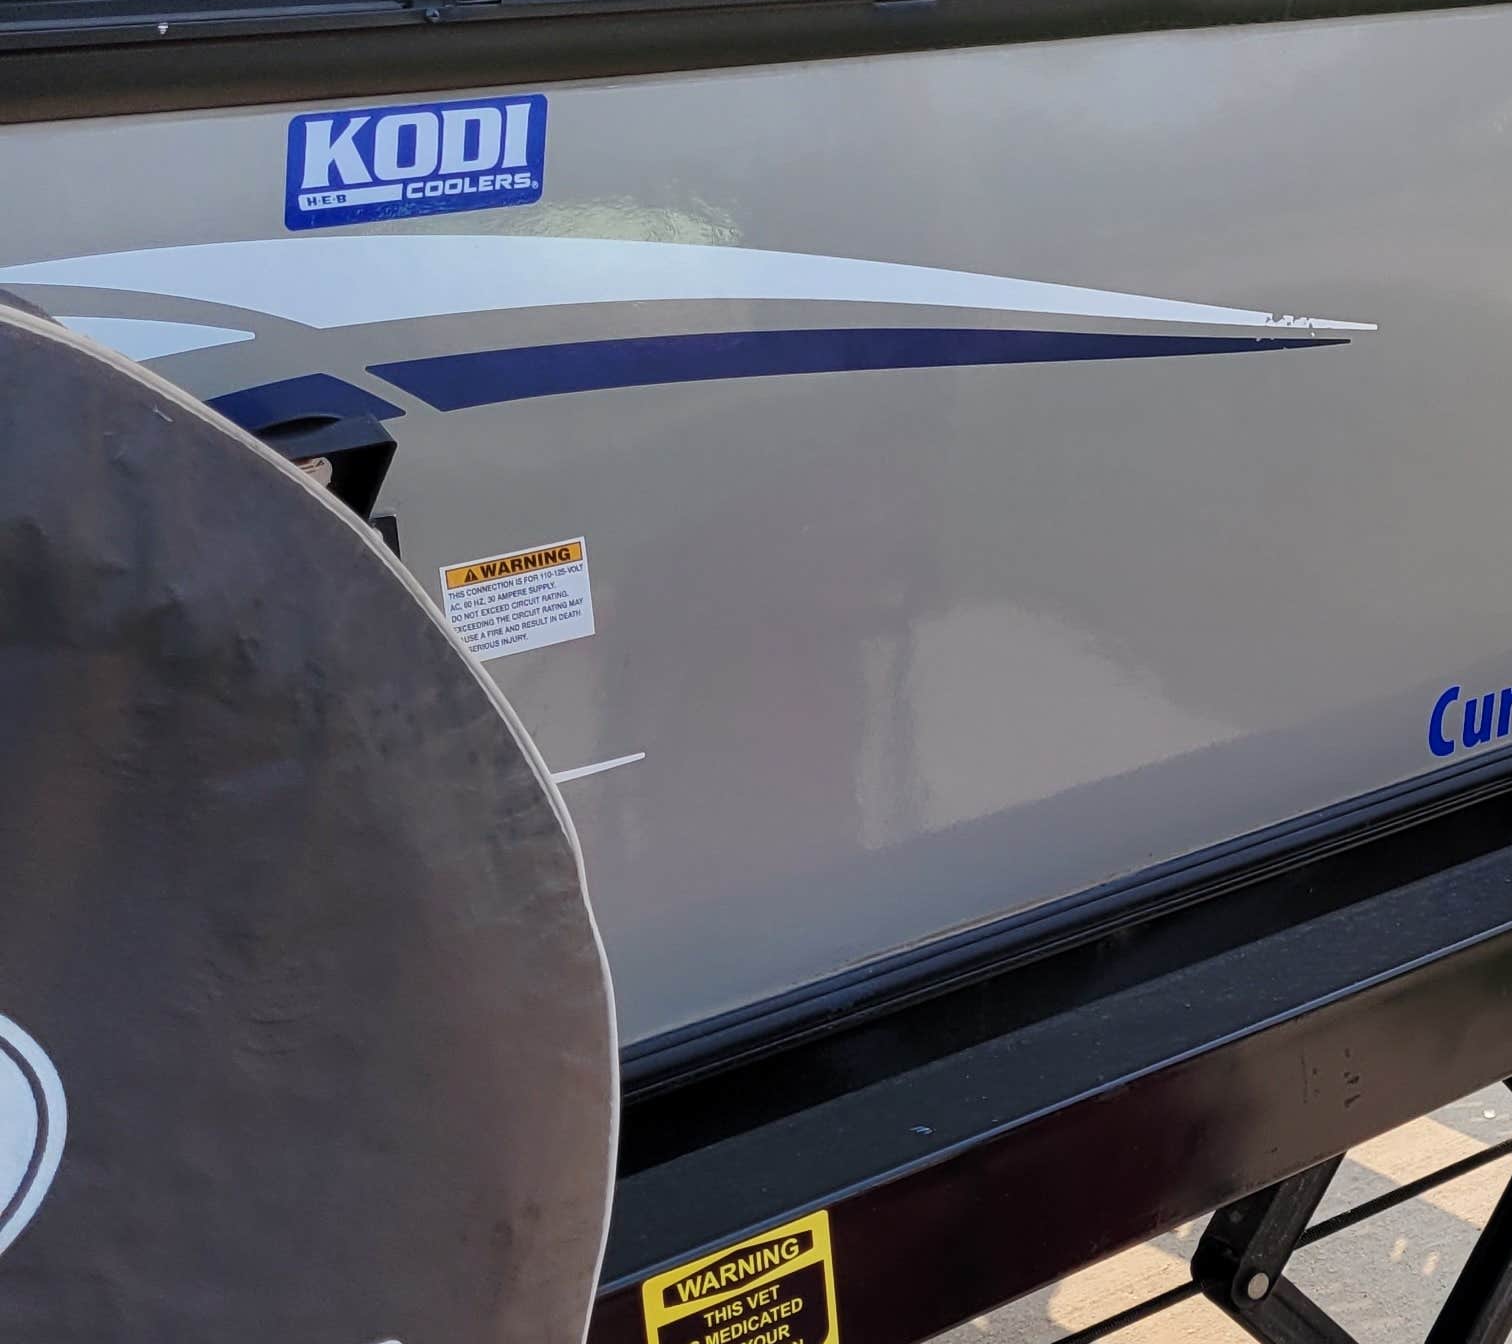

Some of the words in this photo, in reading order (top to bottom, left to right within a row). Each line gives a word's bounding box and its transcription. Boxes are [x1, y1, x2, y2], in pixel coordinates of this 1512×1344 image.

[300, 103, 531, 189] KODI
[480, 548, 571, 578] WARNING
[448, 591, 465, 600] THIS
[466, 580, 514, 597] CONNECTION
[516, 578, 523, 586] IS
[524, 574, 539, 584] FOR
[464, 600, 472, 609] 60
[488, 596, 496, 604] 30
[498, 588, 527, 602] AMPERE
[452, 613, 462, 623] DO
[464, 611, 479, 620] NOT
[481, 604, 510, 617] EXCEED
[512, 597, 539, 610] CIRCUIT
[496, 615, 510, 625] THE
[512, 608, 540, 621] CIRCUIT
[542, 601, 567, 613] RATING
[569, 598, 583, 608] MAY
[461, 633, 479, 644] USE
[480, 631, 486, 639] A
[487, 626, 503, 637] FIRE
[505, 624, 520, 633] AND
[522, 616, 548, 630] RESULT
[550, 615, 558, 624] IN
[677, 1237, 800, 1302] WARNING
[704, 1300, 744, 1327] THIS
[746, 1284, 780, 1309] VET
